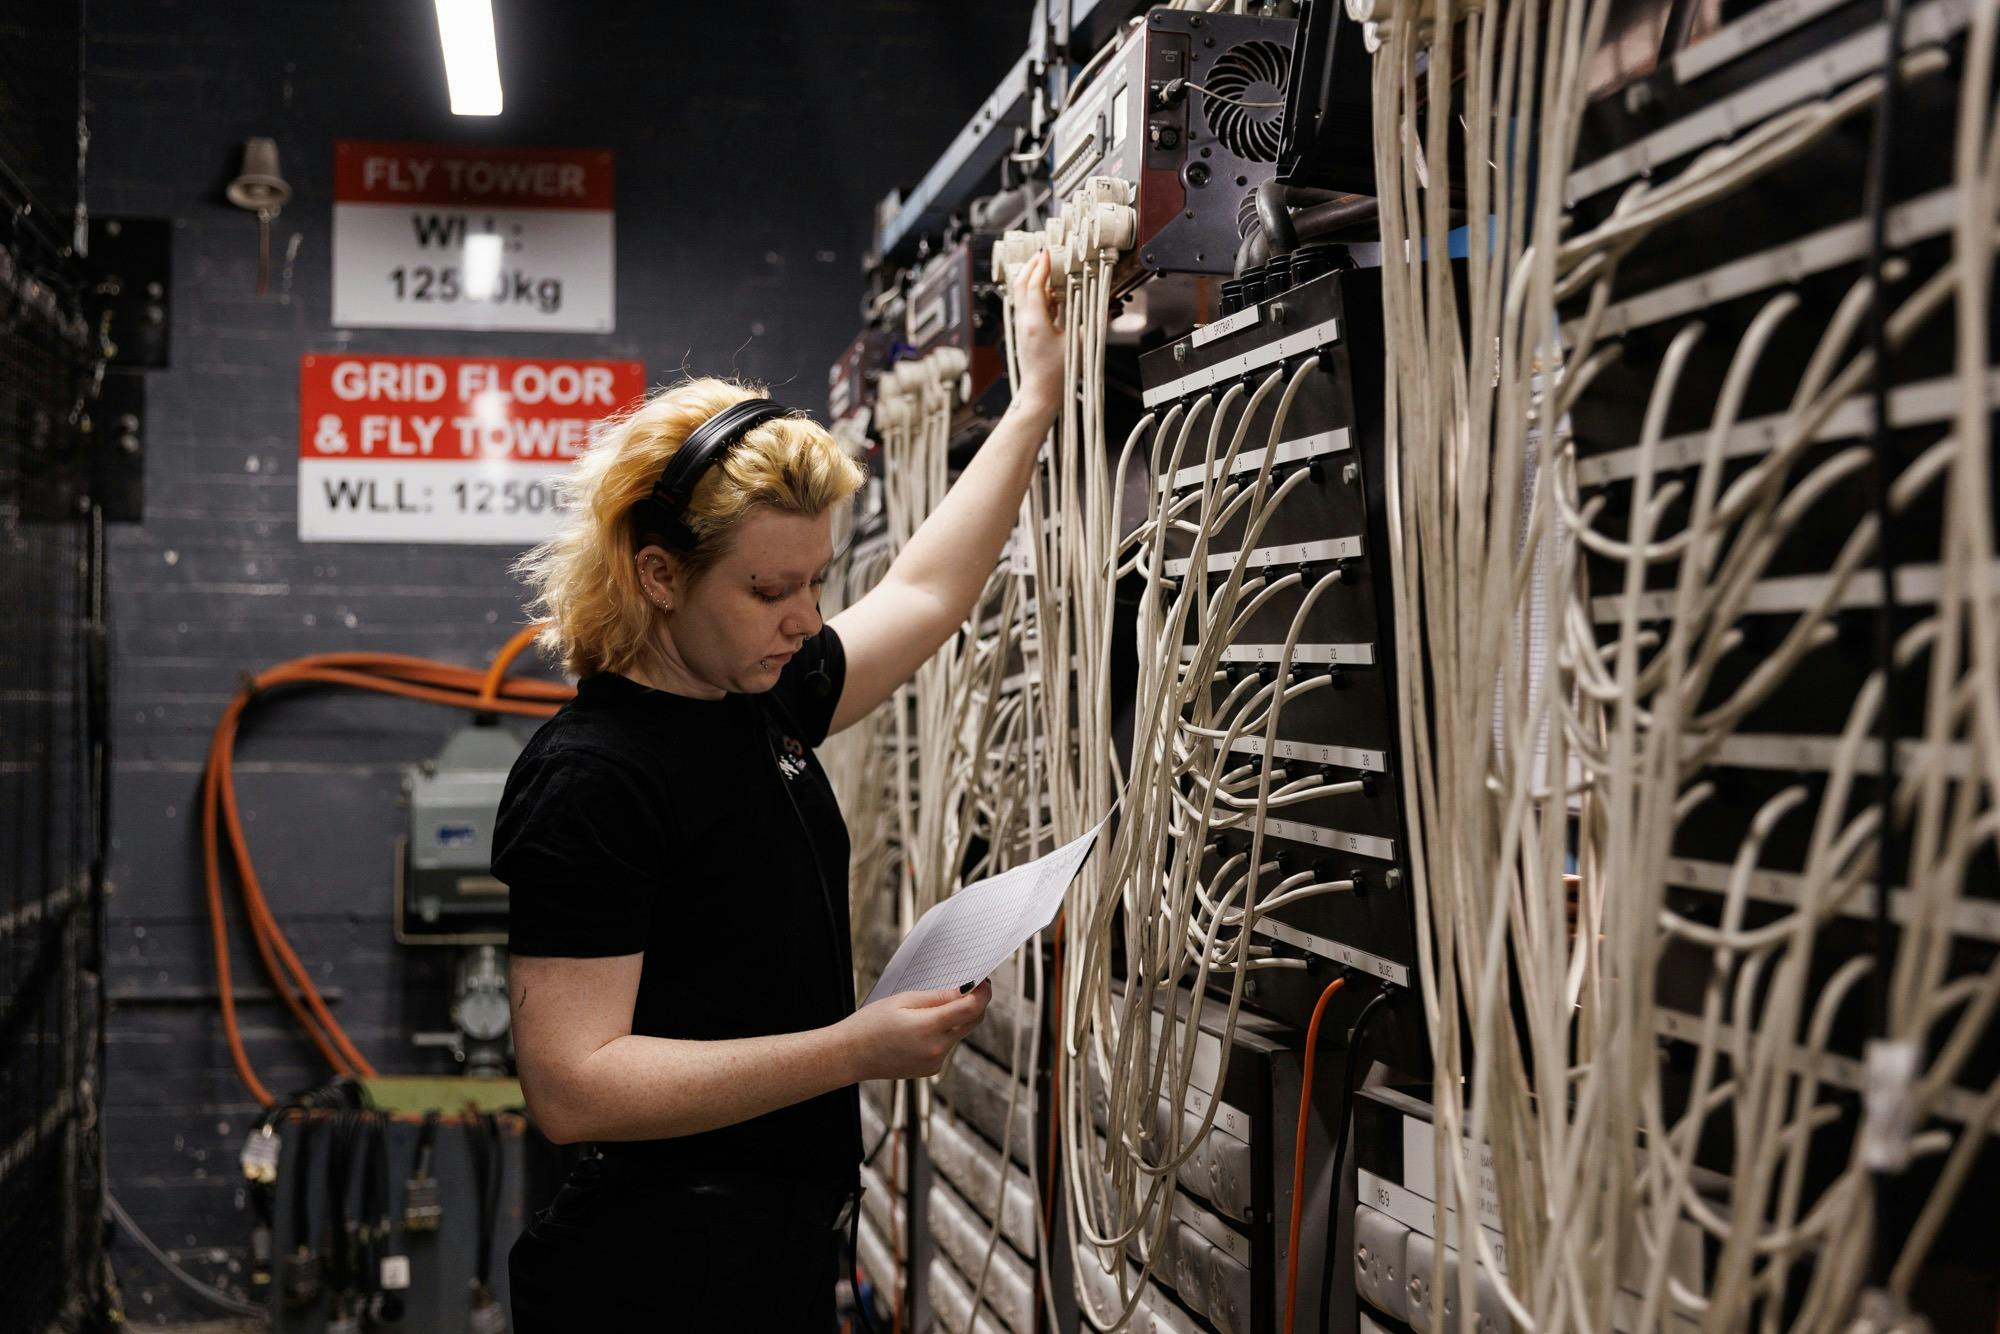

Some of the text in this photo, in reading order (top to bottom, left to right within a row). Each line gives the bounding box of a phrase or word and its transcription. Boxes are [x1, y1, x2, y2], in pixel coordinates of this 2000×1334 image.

[363, 156, 587, 196] FLY TOWER
[331, 361, 615, 405] GRID FLOOR
[314, 415, 349, 454] &
[360, 416, 444, 456] FLY
[322, 476, 433, 514] WLL:
[1329, 646, 1337, 660] 22
[1311, 830, 1318, 842] 32
[1378, 961, 1394, 979] BLUES
[1226, 1112, 1235, 1130] 150
[1377, 1185, 1390, 1208] 169
